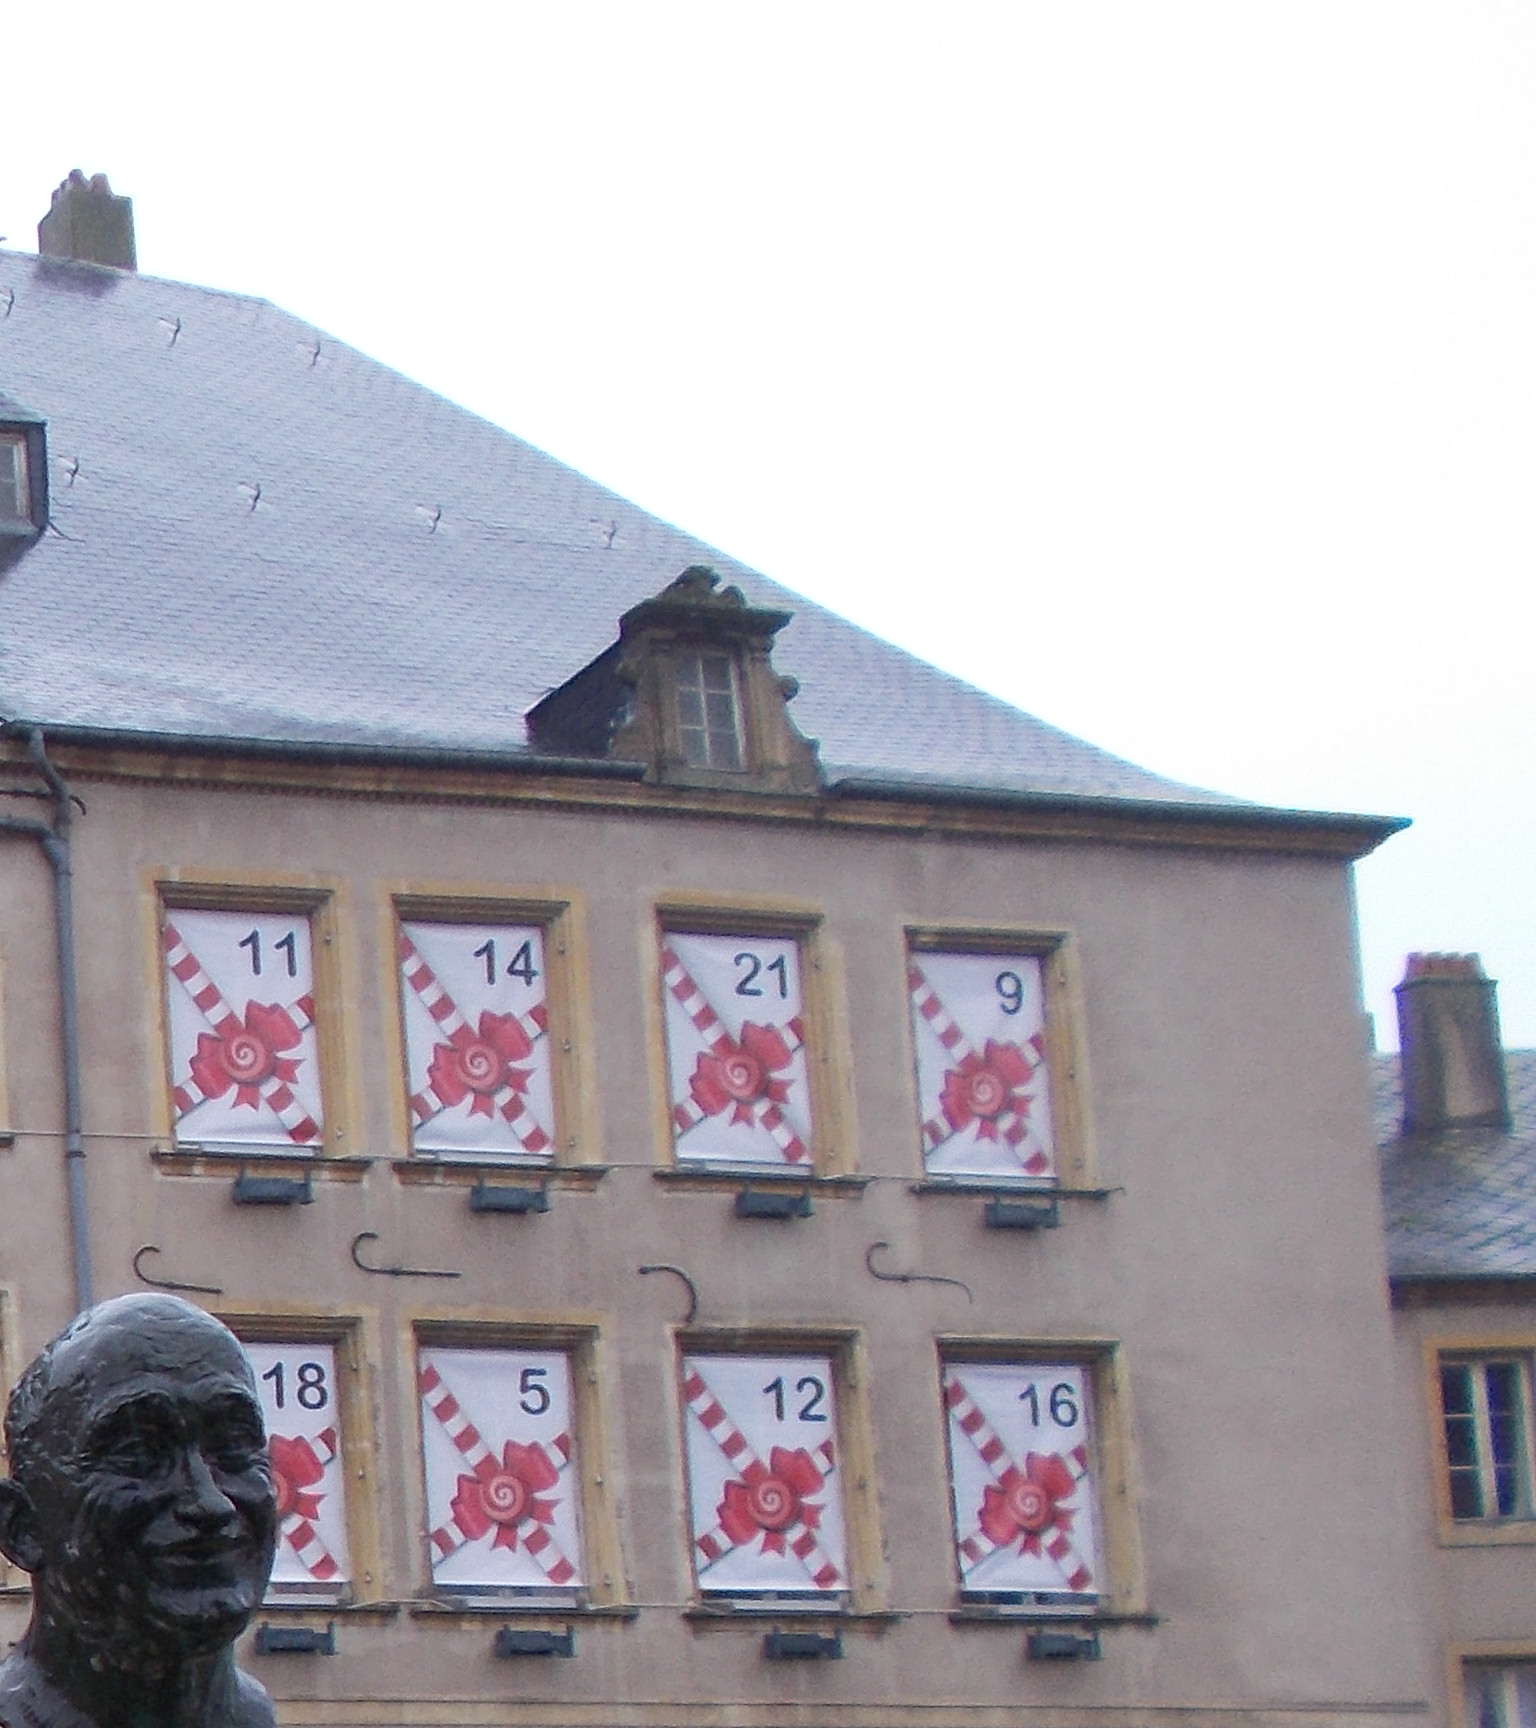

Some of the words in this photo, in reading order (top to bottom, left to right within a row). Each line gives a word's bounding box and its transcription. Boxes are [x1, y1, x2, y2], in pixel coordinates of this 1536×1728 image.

[239, 930, 296, 977] 11
[474, 938, 538, 986] 14
[734, 953, 787, 998] 21
[996, 972, 1022, 1014] 9
[263, 1362, 327, 1409] 18
[520, 1369, 550, 1414] 5
[763, 1377, 826, 1421] 12
[1020, 1383, 1078, 1427] 16
